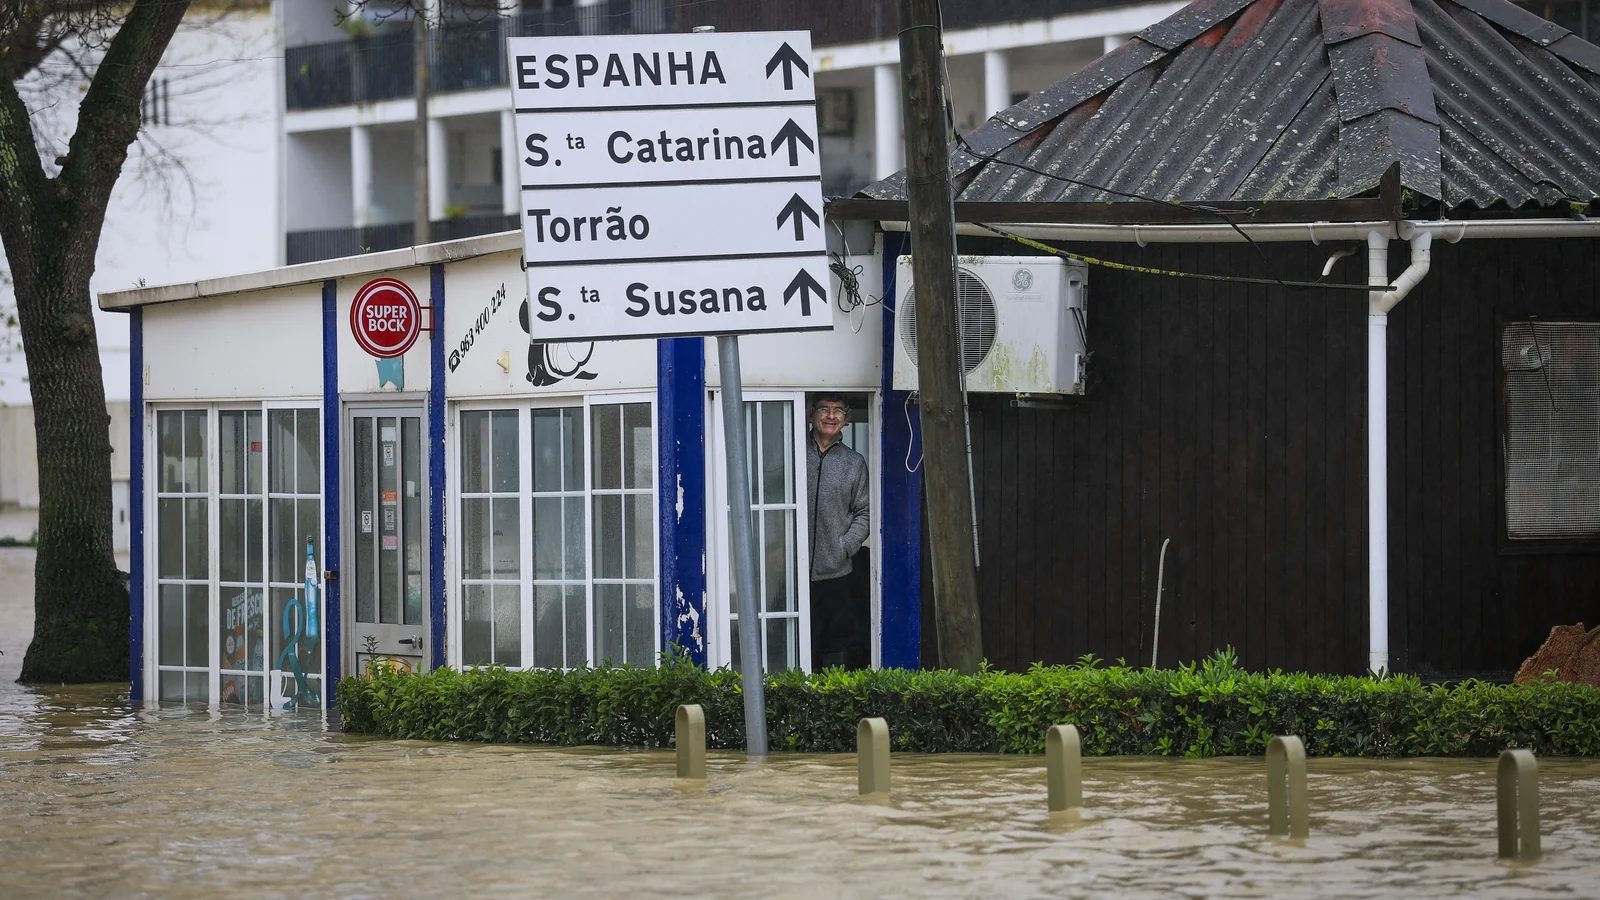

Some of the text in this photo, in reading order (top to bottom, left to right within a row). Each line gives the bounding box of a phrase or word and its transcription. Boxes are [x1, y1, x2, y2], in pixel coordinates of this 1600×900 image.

[515, 50, 727, 90] ESPANHA
[607, 127, 767, 165] Catarina
[527, 206, 650, 243] Torrão
[366, 304, 408, 319] SUPER
[624, 282, 768, 318] Susana
[368, 318, 406, 332] BOCK
[460, 282, 506, 358] 963 400 224
[226, 608, 236, 630] DE
